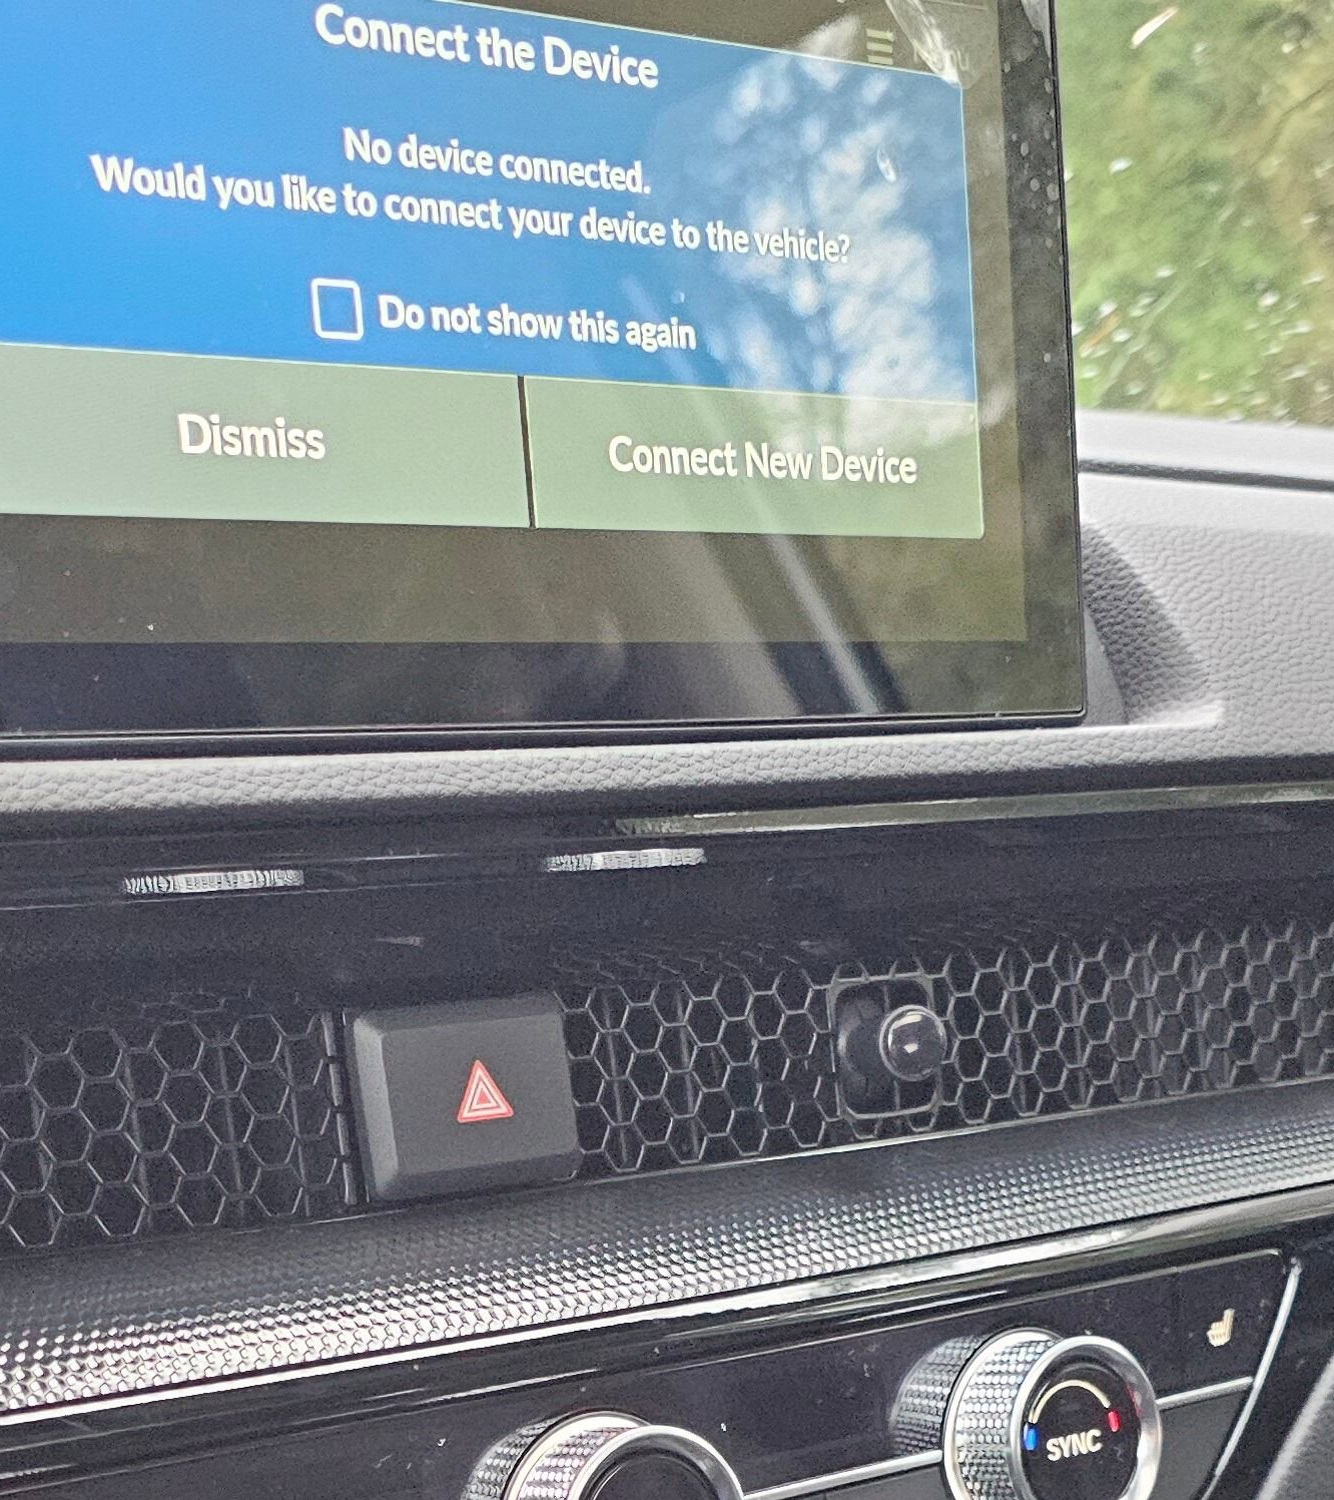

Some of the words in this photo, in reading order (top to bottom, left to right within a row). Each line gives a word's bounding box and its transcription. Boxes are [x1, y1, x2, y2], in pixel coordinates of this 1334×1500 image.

[314, 4, 469, 62] Connect
[476, 28, 536, 70] the
[543, 36, 659, 87] Device
[343, 128, 392, 163] No
[399, 134, 492, 178] device
[499, 148, 651, 194] connected.
[90, 153, 207, 202] Would
[213, 175, 275, 209] you
[282, 175, 337, 214] like
[342, 184, 378, 217] to
[384, 192, 503, 231] connect
[507, 205, 571, 241] your
[579, 206, 666, 246] device
[670, 218, 700, 249] to
[705, 221, 749, 256] the
[754, 227, 851, 263] vehicle?
[378, 295, 425, 331] Do
[430, 303, 481, 336] not
[487, 308, 562, 342] show
[569, 309, 621, 345] this
[625, 318, 696, 354] again
[178, 413, 326, 460] Dismiss
[608, 435, 738, 477] Connect
[745, 442, 813, 480] New
[820, 443, 919, 484] Device
[1046, 1428, 1101, 1462] SYNC
